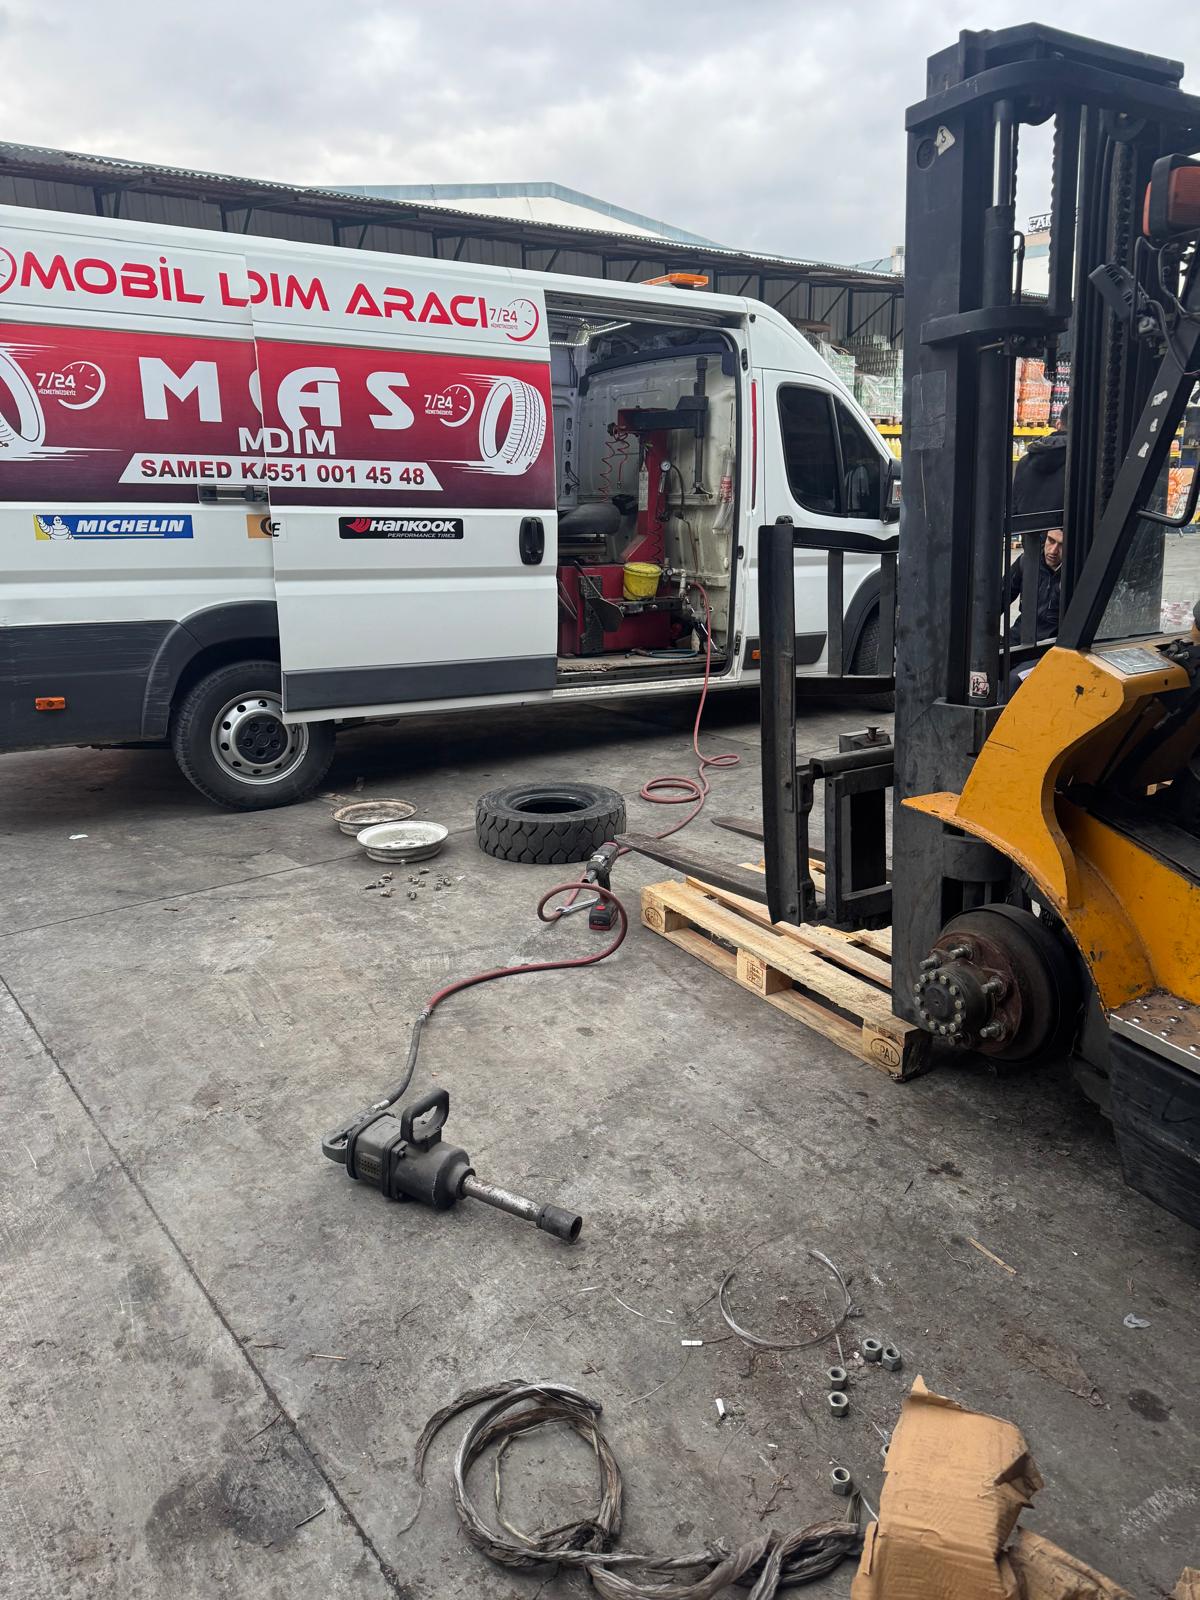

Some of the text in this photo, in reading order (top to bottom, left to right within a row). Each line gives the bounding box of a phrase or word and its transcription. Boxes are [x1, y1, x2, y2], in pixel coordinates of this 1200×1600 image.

[21, 251, 205, 303] MOBİL
[345, 283, 488, 328] ARACI
[489, 308, 517, 323] 7/24
[36, 371, 76, 388] 7/24
[424, 394, 453, 409] 7/24
[141, 460, 232, 479] SAMED
[317, 465, 356, 483] 001
[366, 467, 392, 485] 45
[400, 467, 425, 485] 48
[76, 519, 185, 533] MICHELIN
